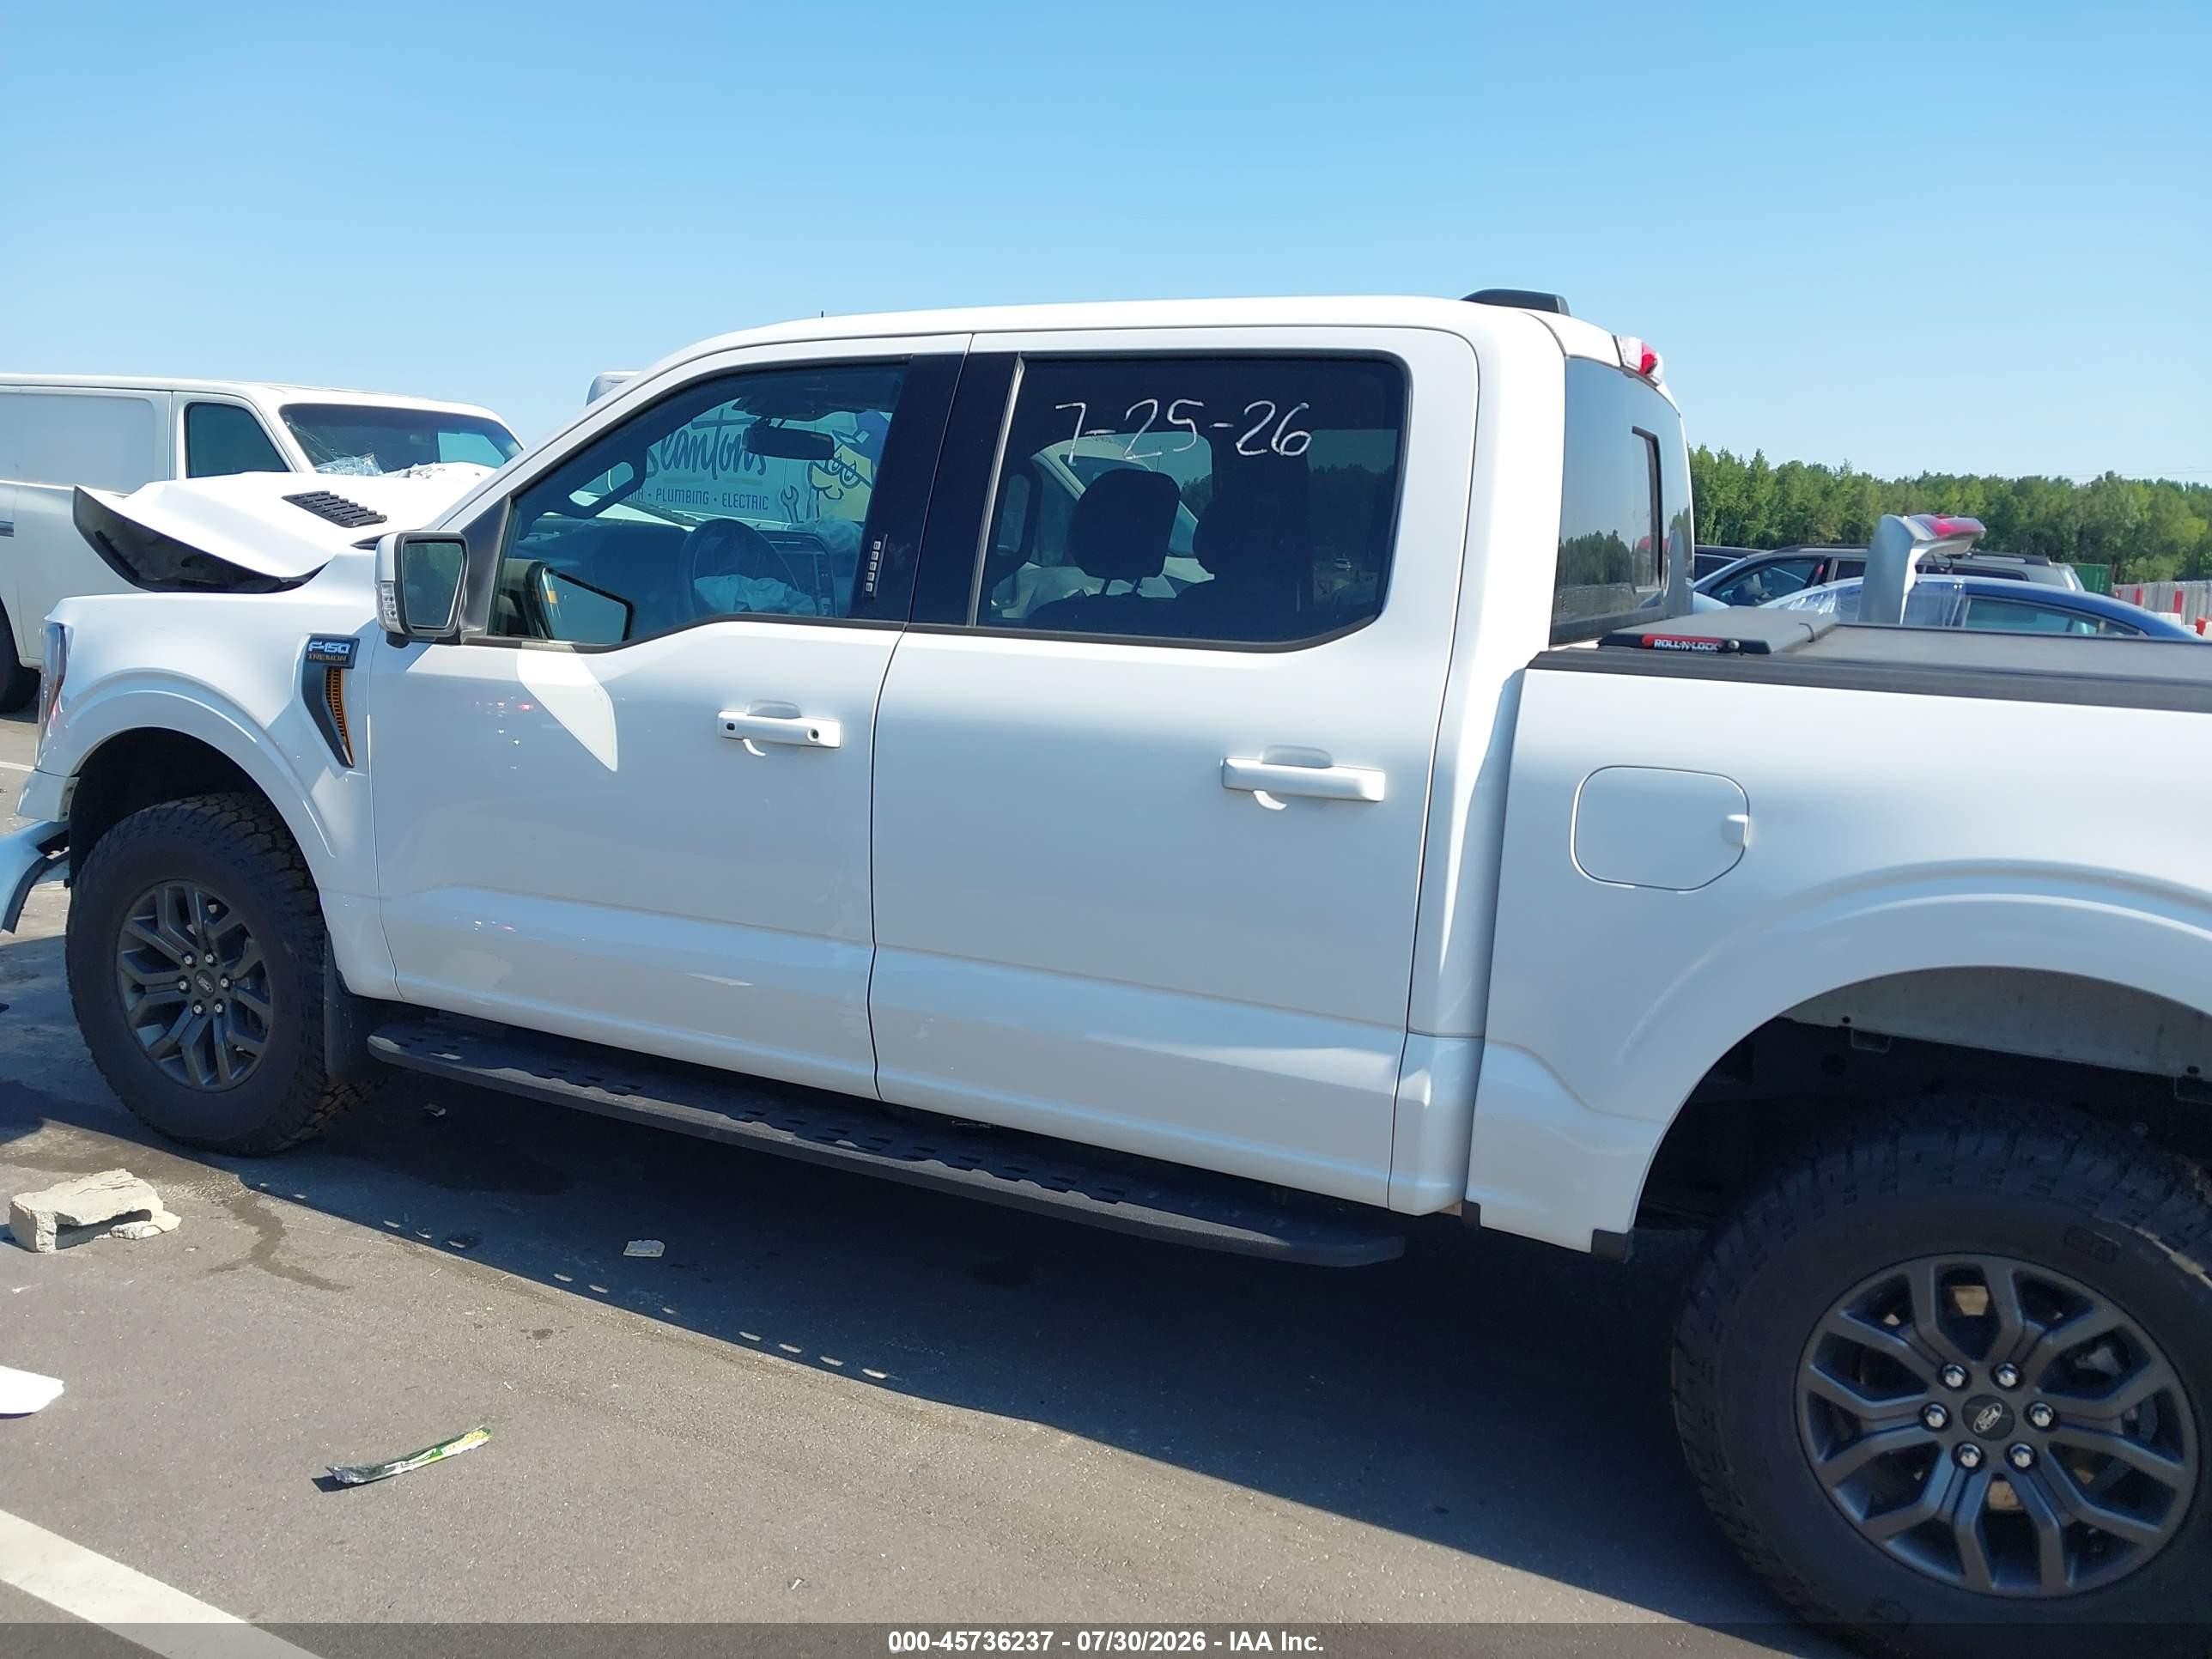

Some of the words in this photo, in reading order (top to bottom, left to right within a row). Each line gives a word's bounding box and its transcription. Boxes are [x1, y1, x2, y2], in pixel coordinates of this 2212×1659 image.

[1054, 398, 1312, 466] 7-25-26
[655, 488, 709, 505] PLUMBING
[721, 492, 769, 510] ELECTRIC
[308, 641, 350, 653] F-150
